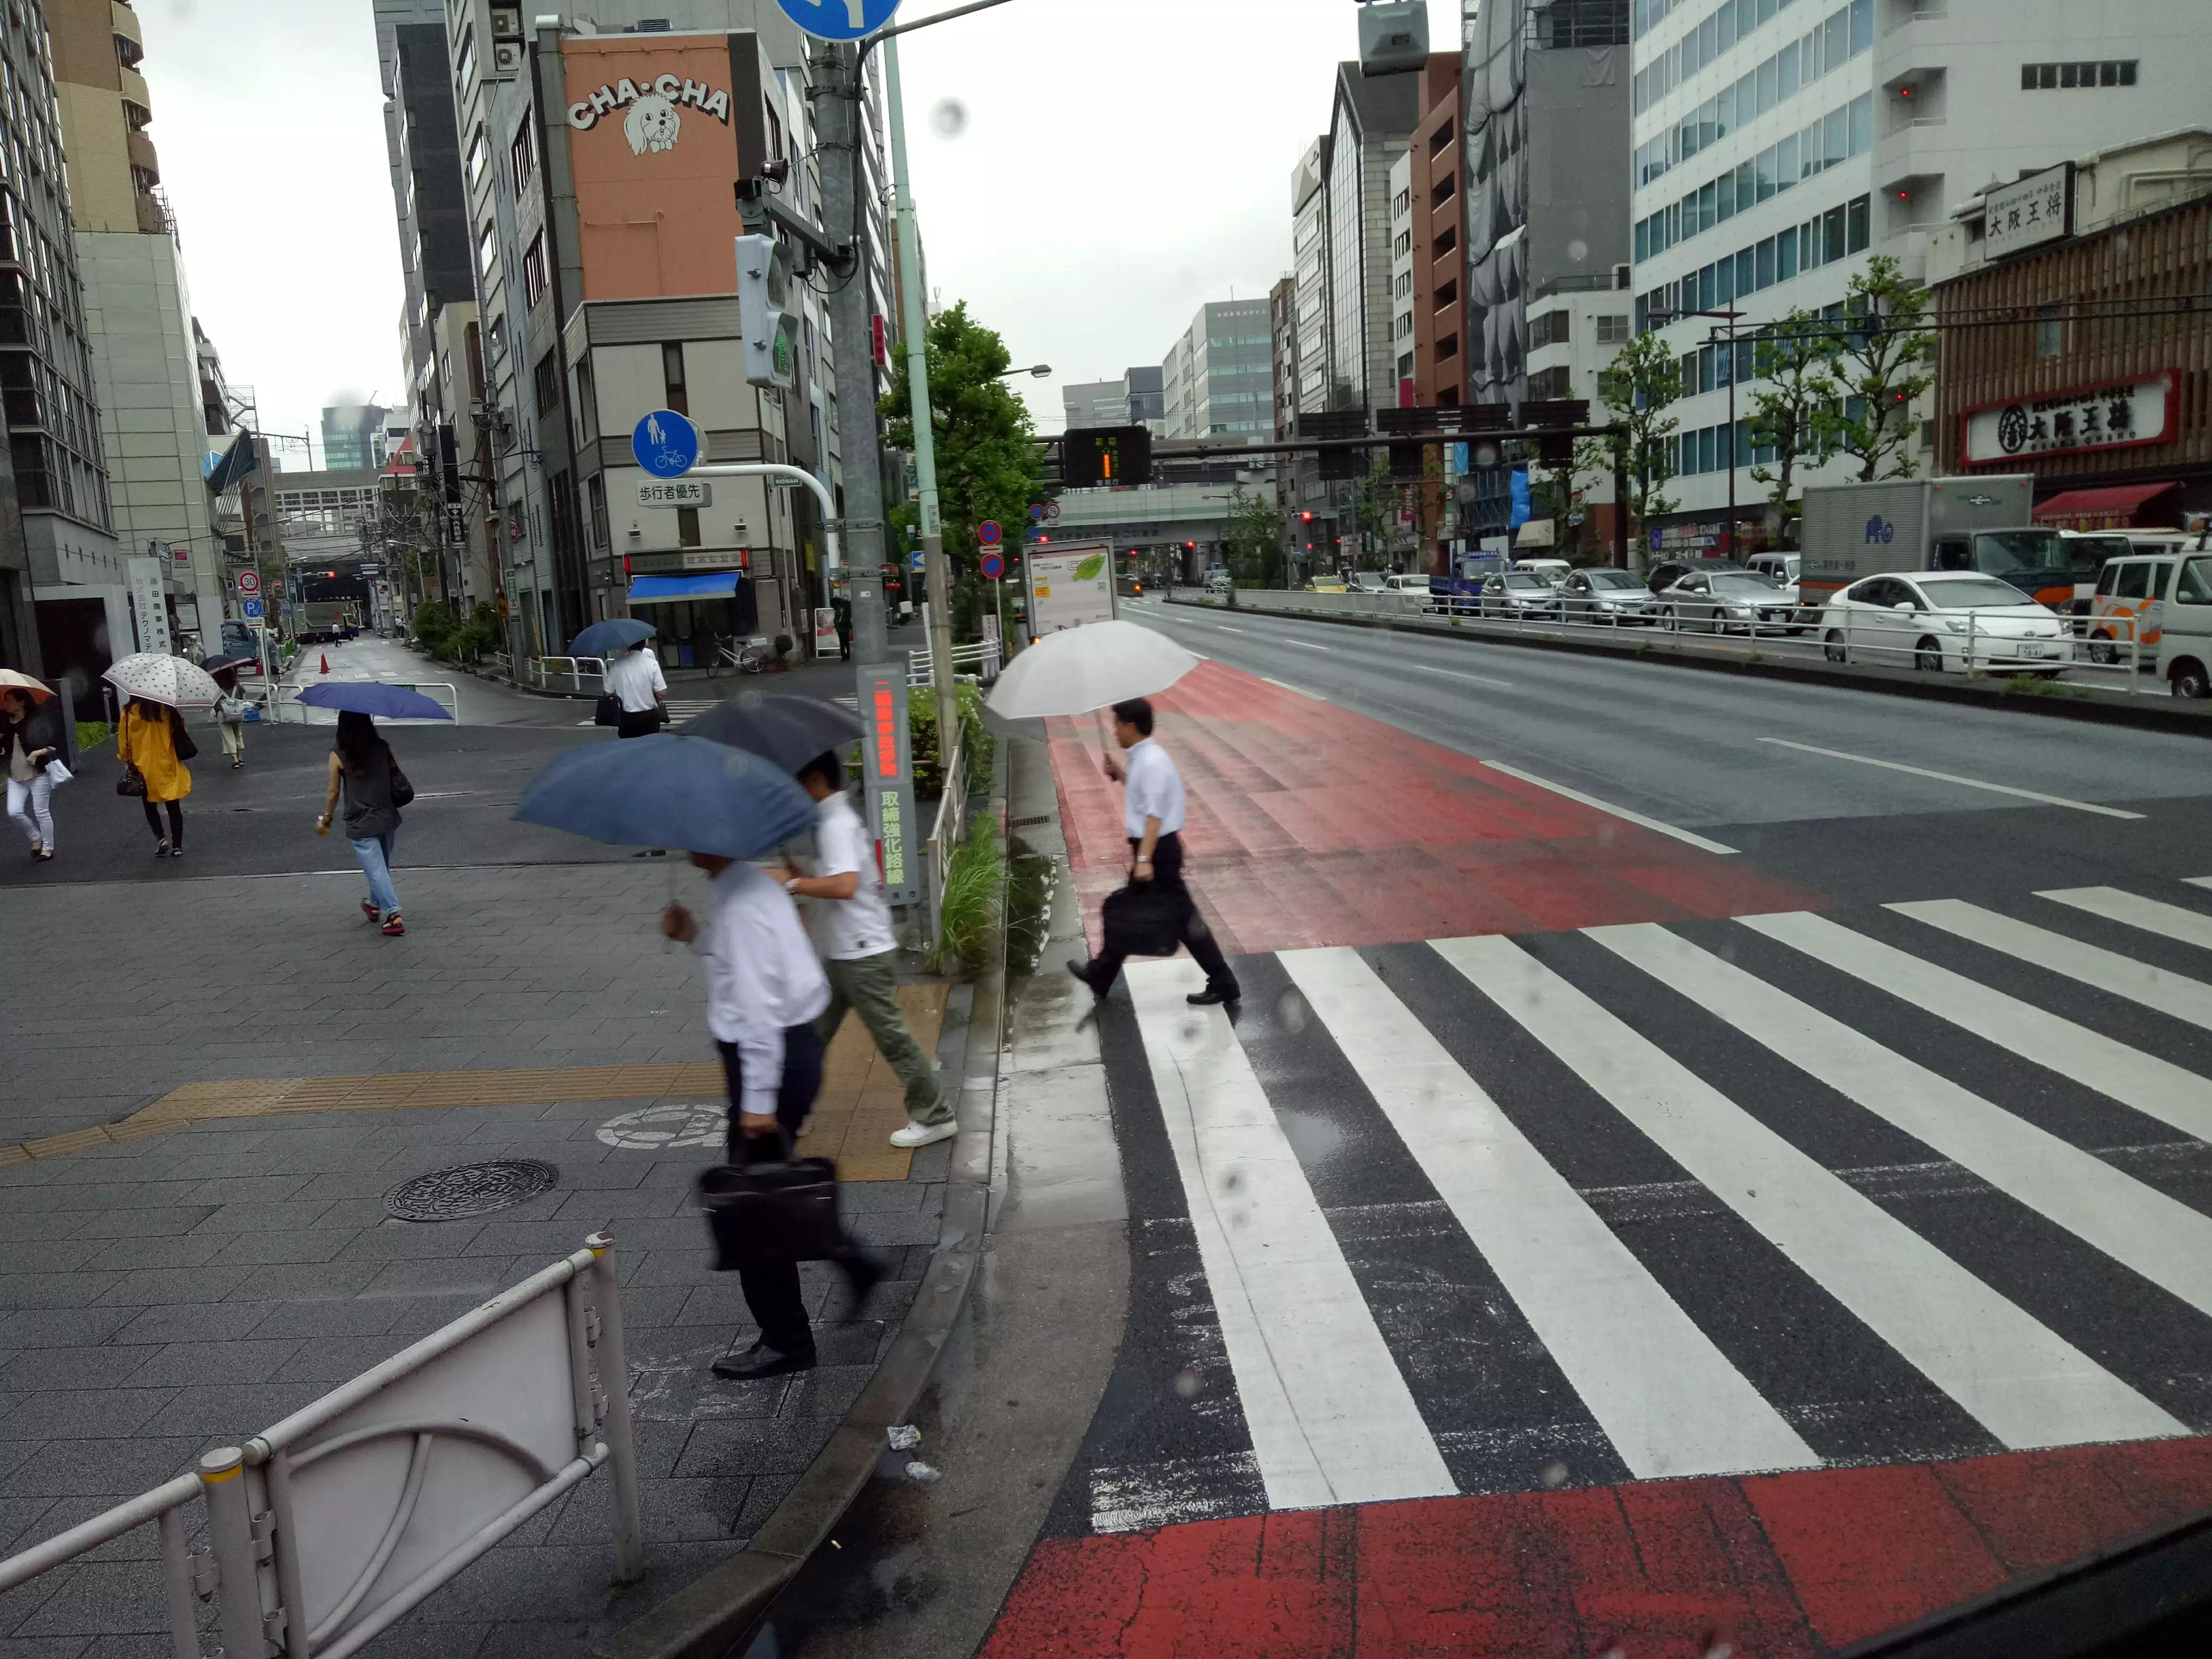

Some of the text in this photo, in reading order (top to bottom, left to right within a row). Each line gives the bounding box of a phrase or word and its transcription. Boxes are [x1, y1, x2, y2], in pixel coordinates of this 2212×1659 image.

[1989, 191, 2062, 237] 大阪王将
[2027, 399, 2130, 441] 大阪王将
[640, 483, 700, 500] 歩行者優先
[136, 578, 153, 654] 株式会社テクノマテ
[247, 602, 255, 615] P
[881, 791, 904, 884] 取締強化路線
